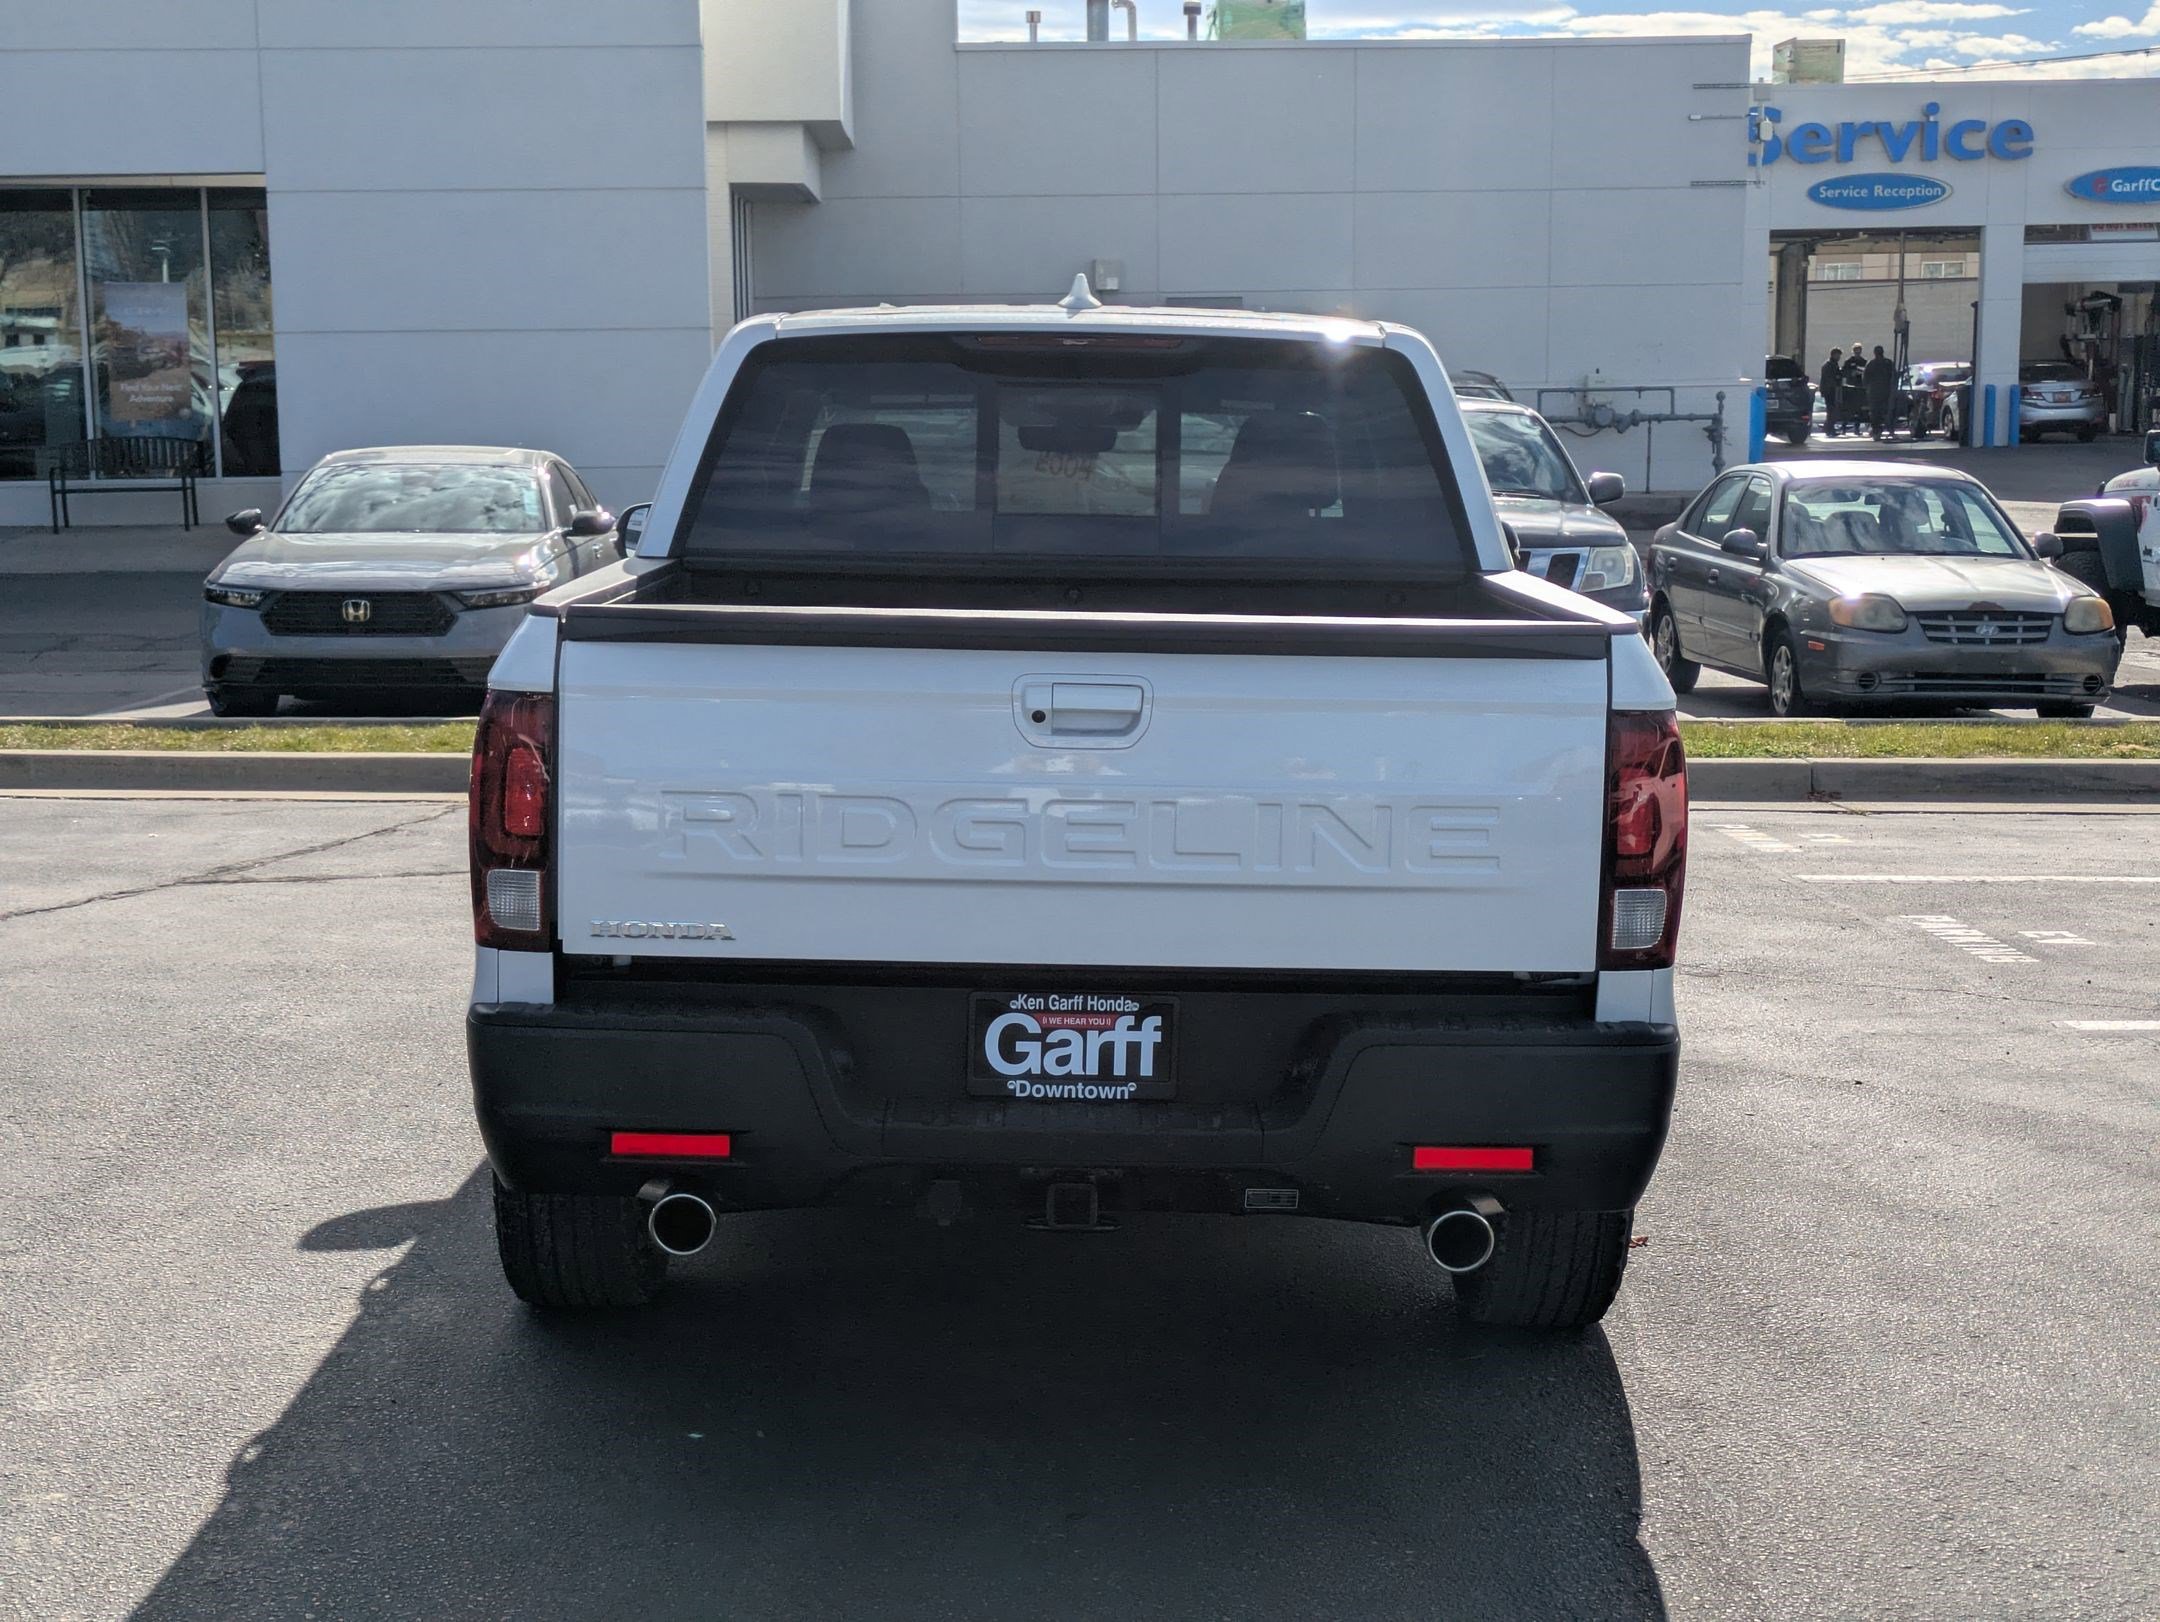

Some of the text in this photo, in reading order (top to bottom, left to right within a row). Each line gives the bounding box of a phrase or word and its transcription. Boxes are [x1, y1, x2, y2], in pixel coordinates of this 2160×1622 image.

[1748, 102, 2034, 166] Service
[1819, 185, 1942, 199] Service Reception
[659, 790, 1500, 874] RIDGELINE
[590, 920, 736, 940] HONDA
[1899, 915, 2040, 963] PARKING
[1017, 993, 1133, 1012] Ken Garff Honda
[1048, 1017, 1106, 1026] WE HEAR YOU
[985, 1012, 1162, 1076] Garff
[1015, 1079, 1129, 1099] Downtown
